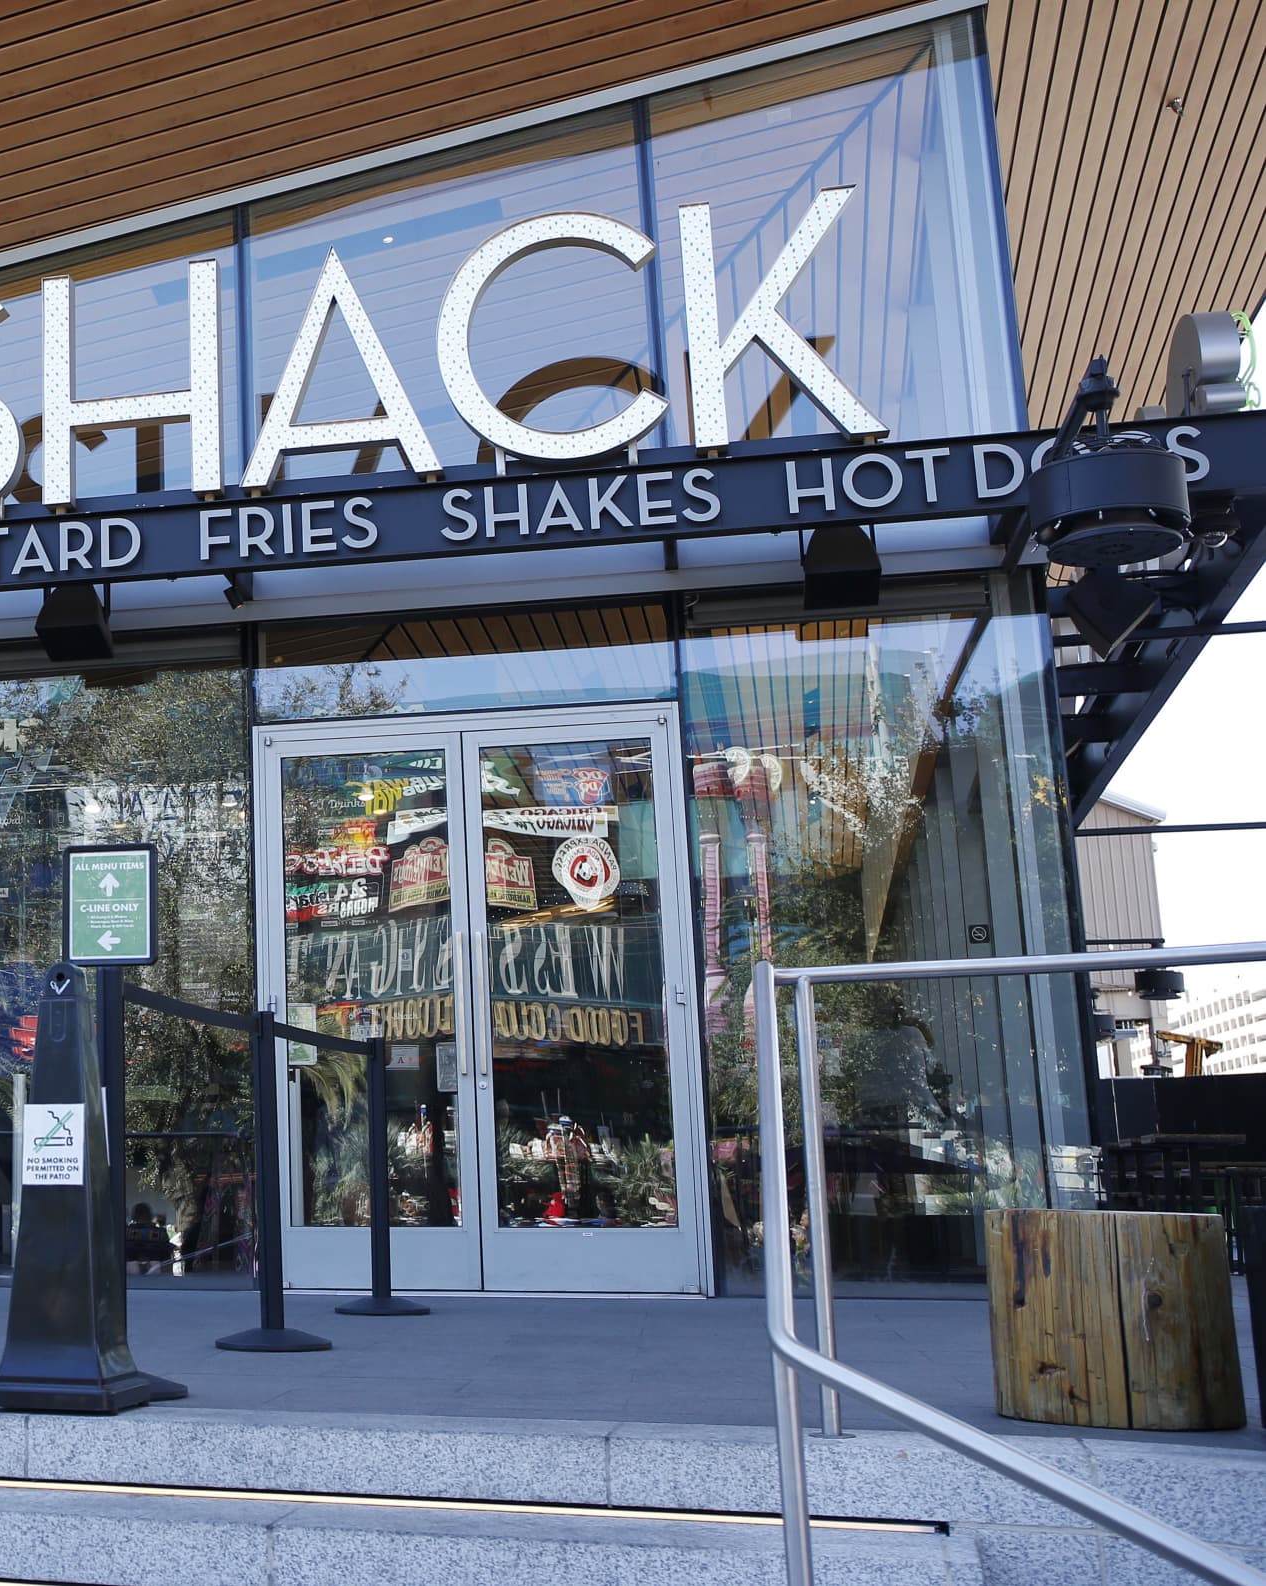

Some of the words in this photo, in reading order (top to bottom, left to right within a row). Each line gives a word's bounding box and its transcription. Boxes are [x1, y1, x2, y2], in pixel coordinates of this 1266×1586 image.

[199, 495, 379, 561] FRIES
[440, 467, 721, 541] SHAKES
[785, 446, 953, 514] HOT
[972, 425, 1210, 499] DS
[75, 862, 90, 871] ALL
[91, 862, 118, 870] MENU
[119, 861, 145, 870] ITEMS
[80, 904, 111, 913] C-LINE
[112, 903, 139, 912] ONLY
